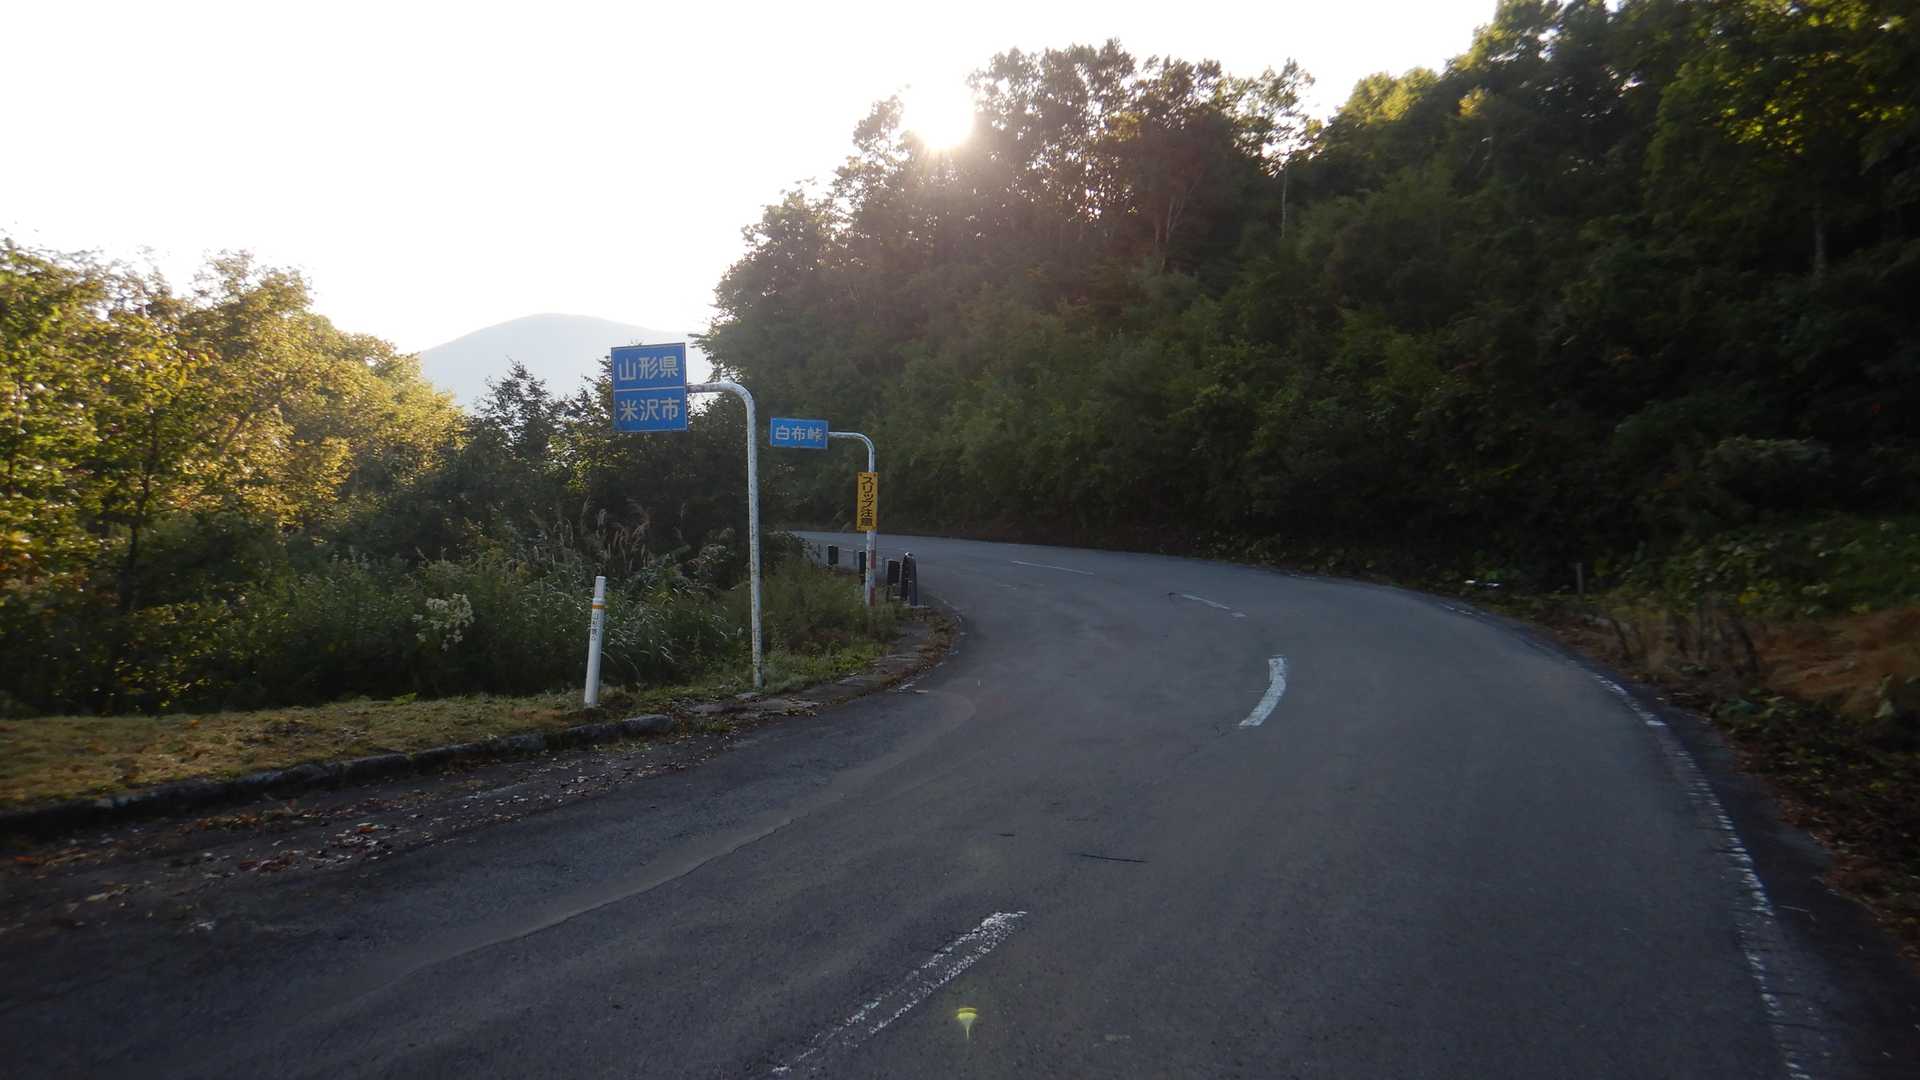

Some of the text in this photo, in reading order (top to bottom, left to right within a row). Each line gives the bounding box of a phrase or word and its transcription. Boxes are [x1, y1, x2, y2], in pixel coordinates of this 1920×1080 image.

[619, 355, 679, 380] 山形県
[620, 397, 680, 421] 米沢市
[775, 424, 825, 442] 白布峠
